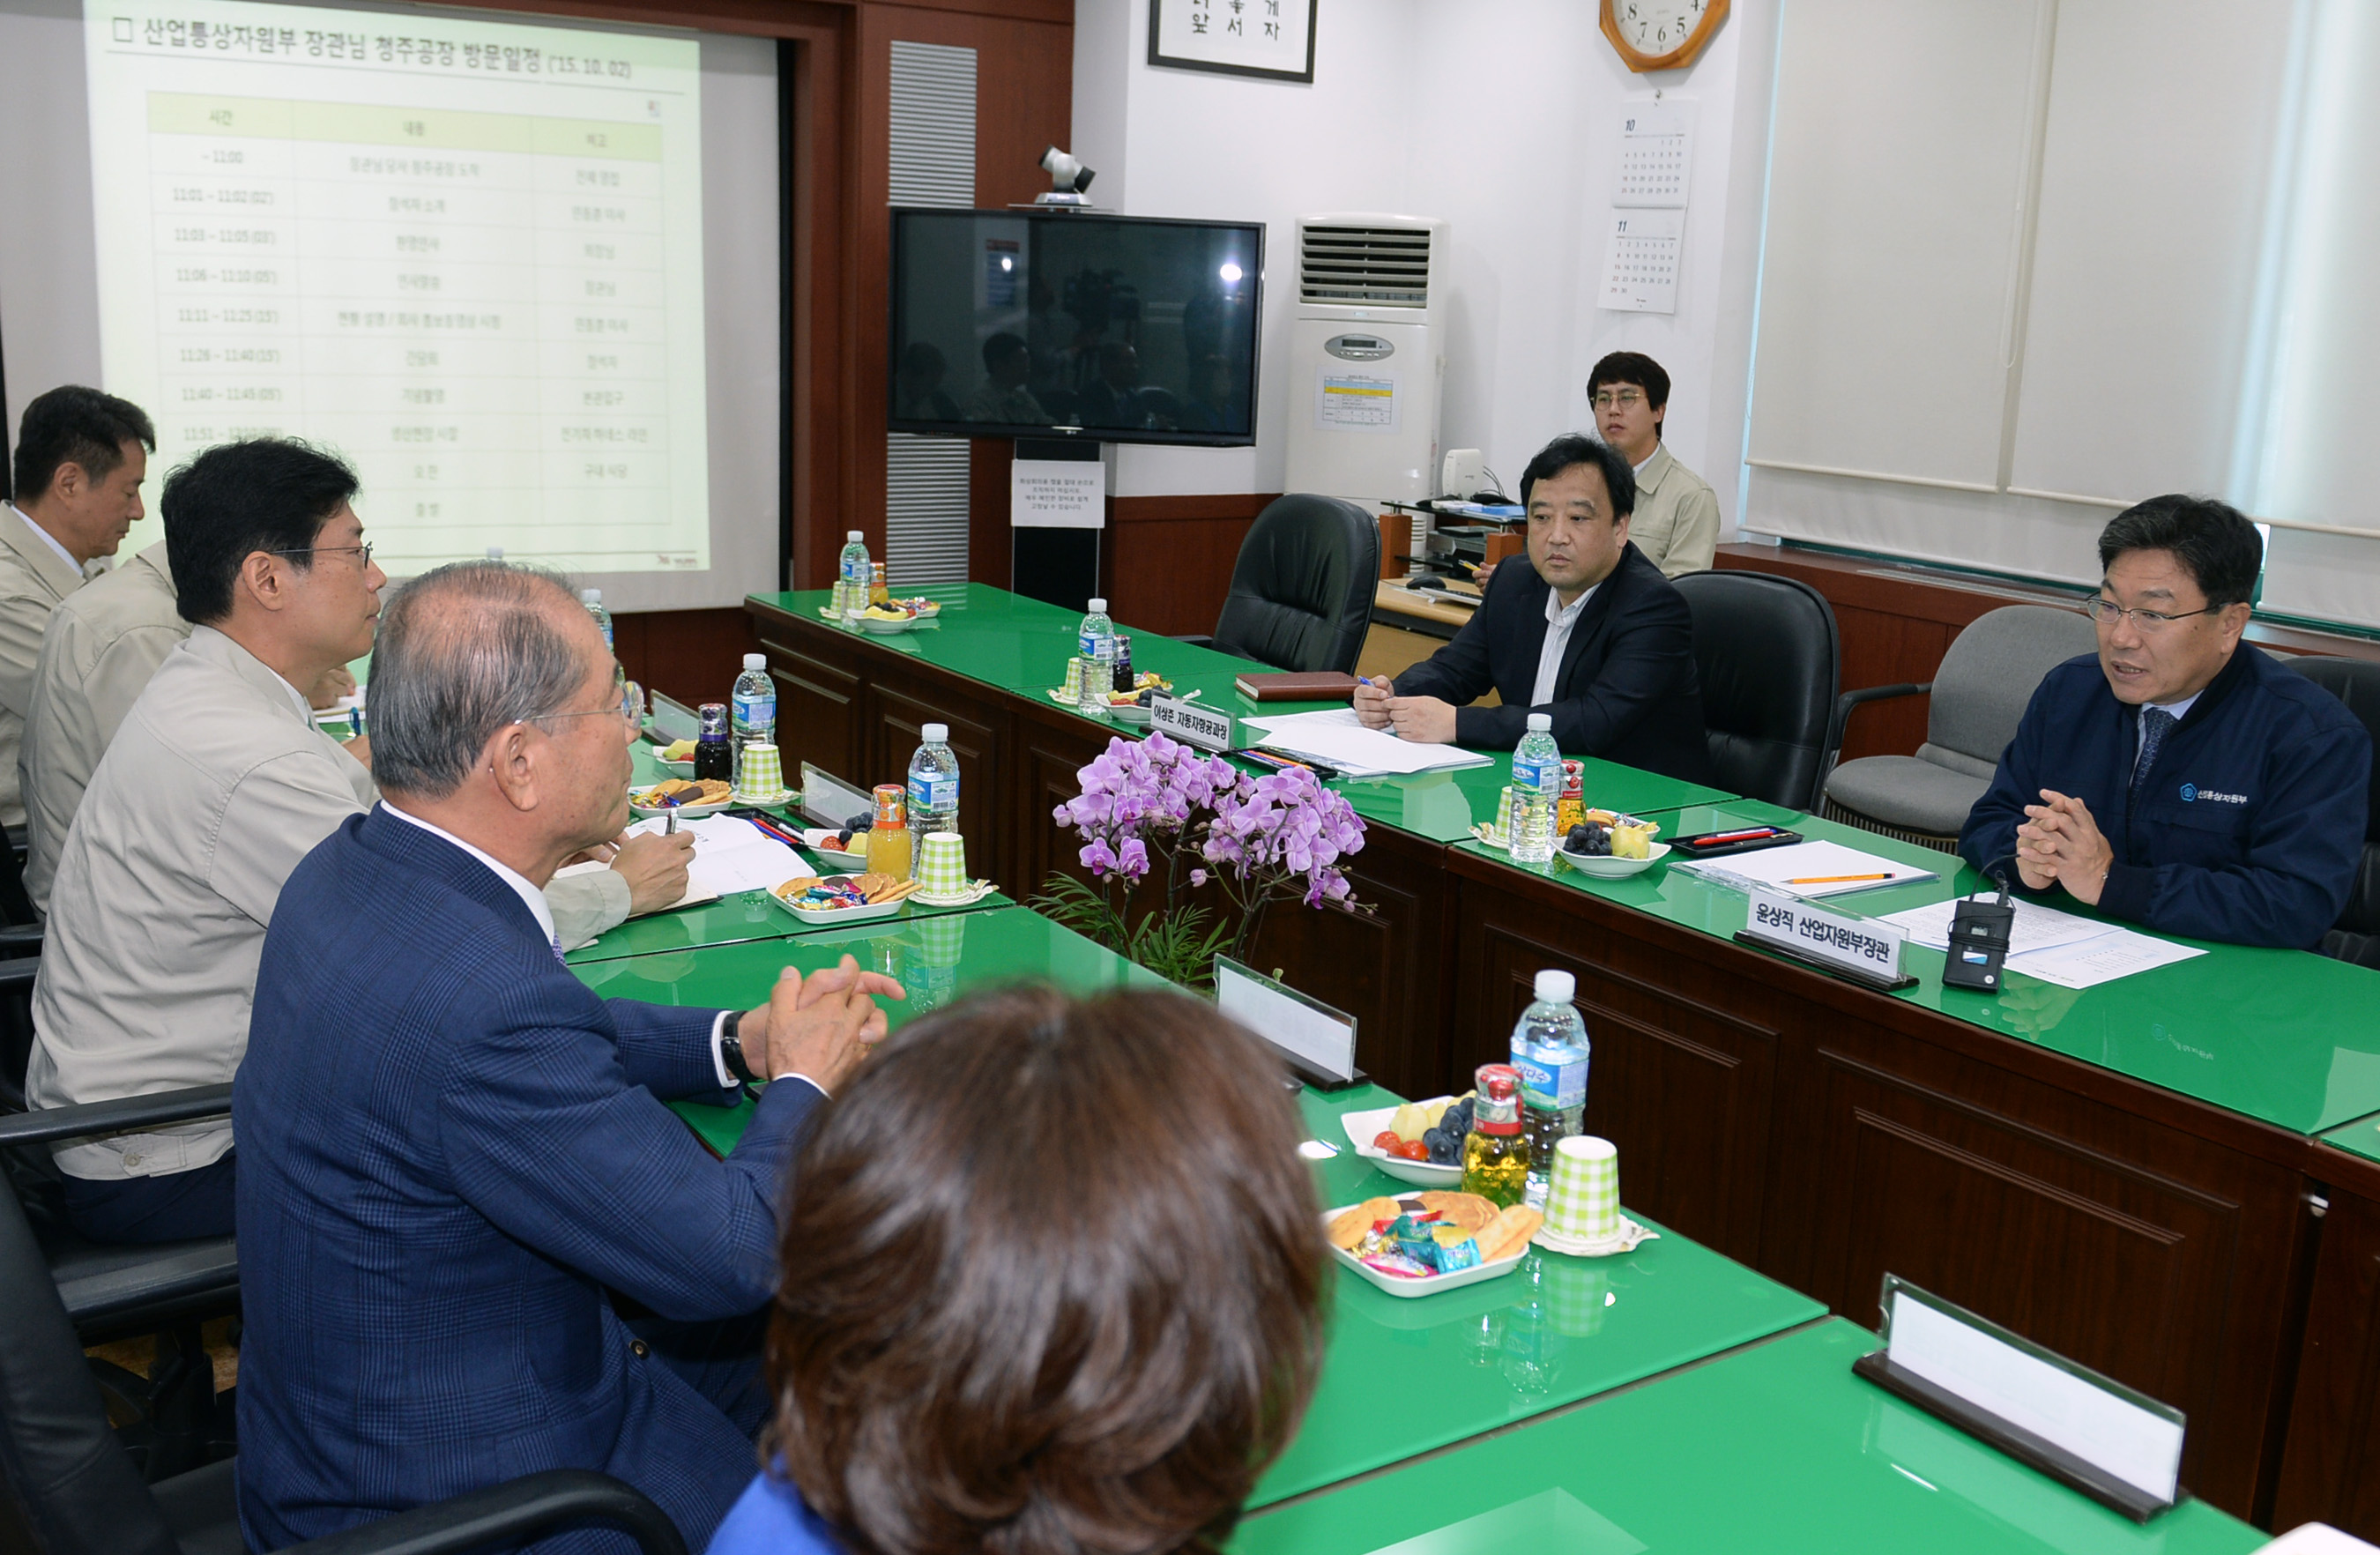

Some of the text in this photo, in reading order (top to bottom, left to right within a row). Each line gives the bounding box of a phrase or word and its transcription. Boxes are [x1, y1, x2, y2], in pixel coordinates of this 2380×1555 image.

[1627, 4, 1637, 20] 8
[1193, 13, 1280, 41] 앞서자
[1640, 22, 1647, 38] 7
[1657, 26, 1666, 42] 6
[1677, 17, 1685, 34] 5
[145, 18, 296, 54] 산업통상자원부
[305, 30, 366, 61] 장관님
[376, 35, 455, 67] 청주공장
[463, 42, 540, 73] 방문일정
[209, 109, 234, 126] 시간
[1625, 119, 1636, 131] 10
[1618, 220, 1627, 233] 11
[1154, 704, 1174, 724] 이상준
[1756, 903, 1794, 932] 윤상직
[1799, 916, 1891, 964] 산업자원부장관
